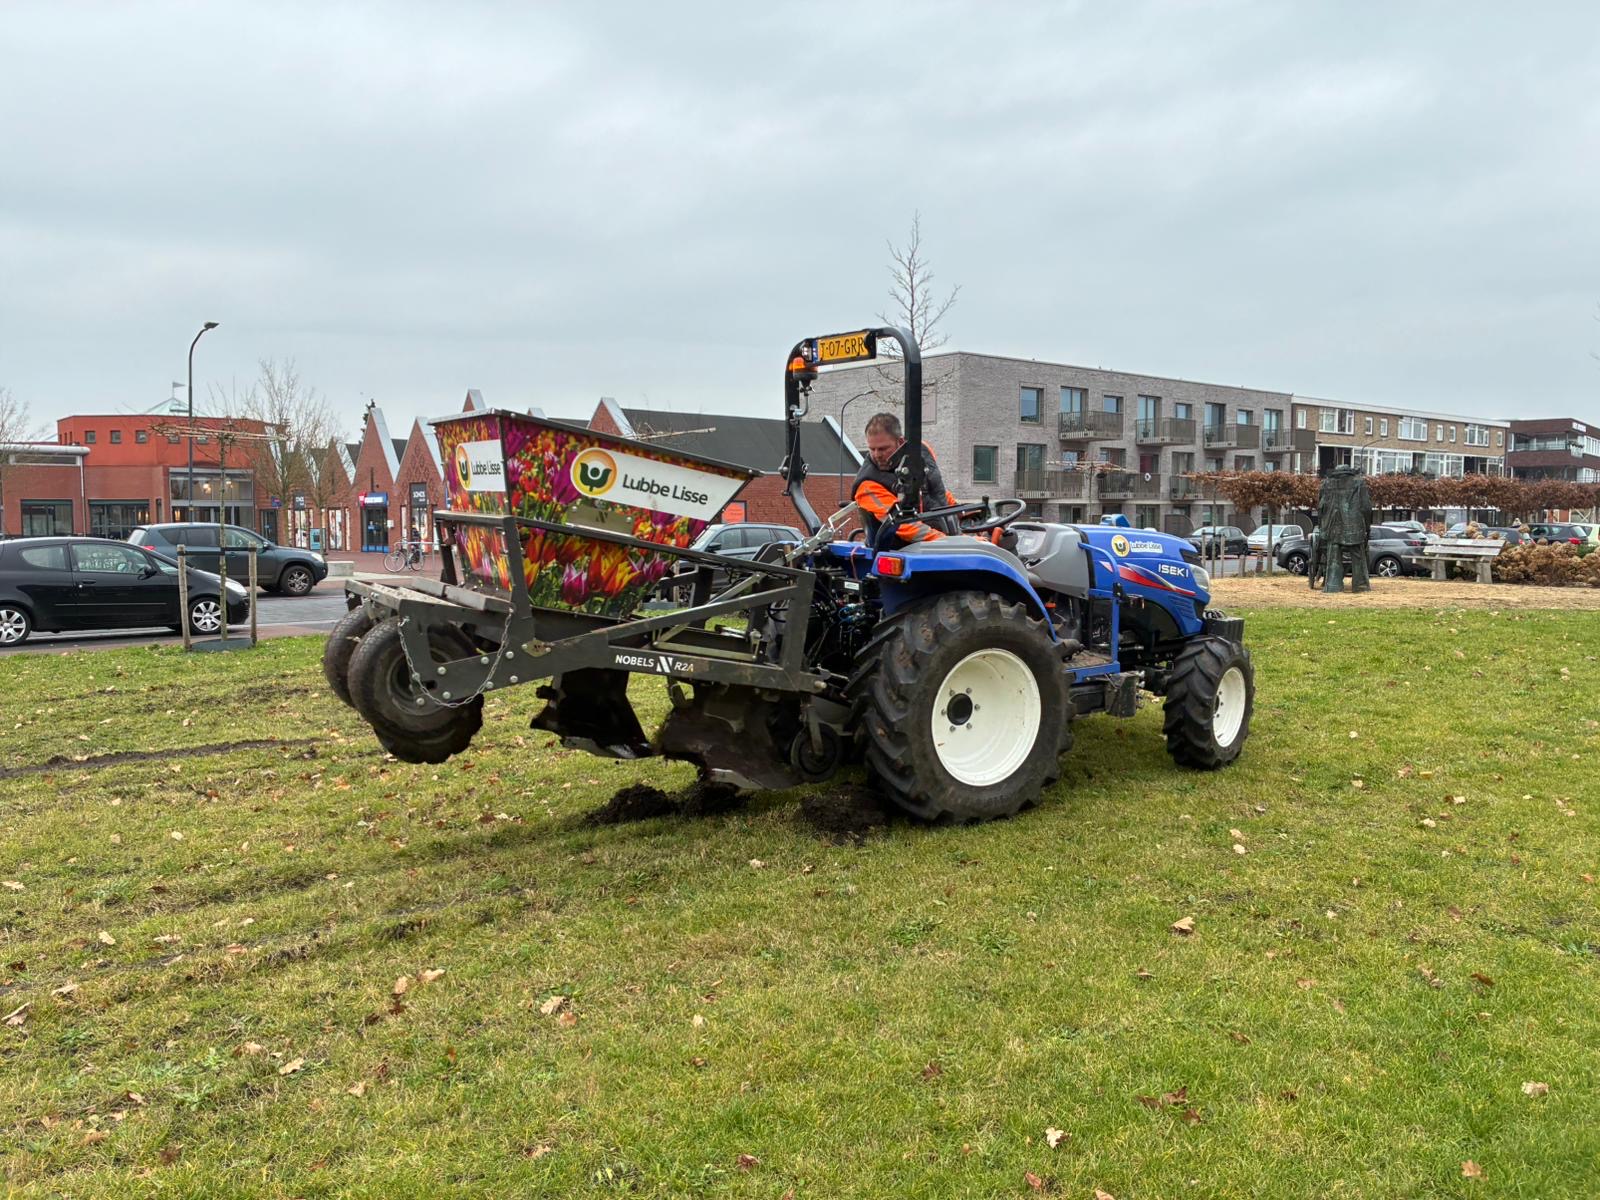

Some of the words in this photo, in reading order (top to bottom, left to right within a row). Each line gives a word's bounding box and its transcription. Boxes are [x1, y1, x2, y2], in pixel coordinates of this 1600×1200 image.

[820, 337, 865, 358] T-07-GRR
[471, 461, 487, 475] Lubbe
[487, 460, 501, 475] Lisse
[622, 474, 670, 497] Lubbe
[672, 485, 708, 505] Lisse
[1159, 564, 1188, 577] ISEKI
[615, 654, 655, 667] NOBELS
